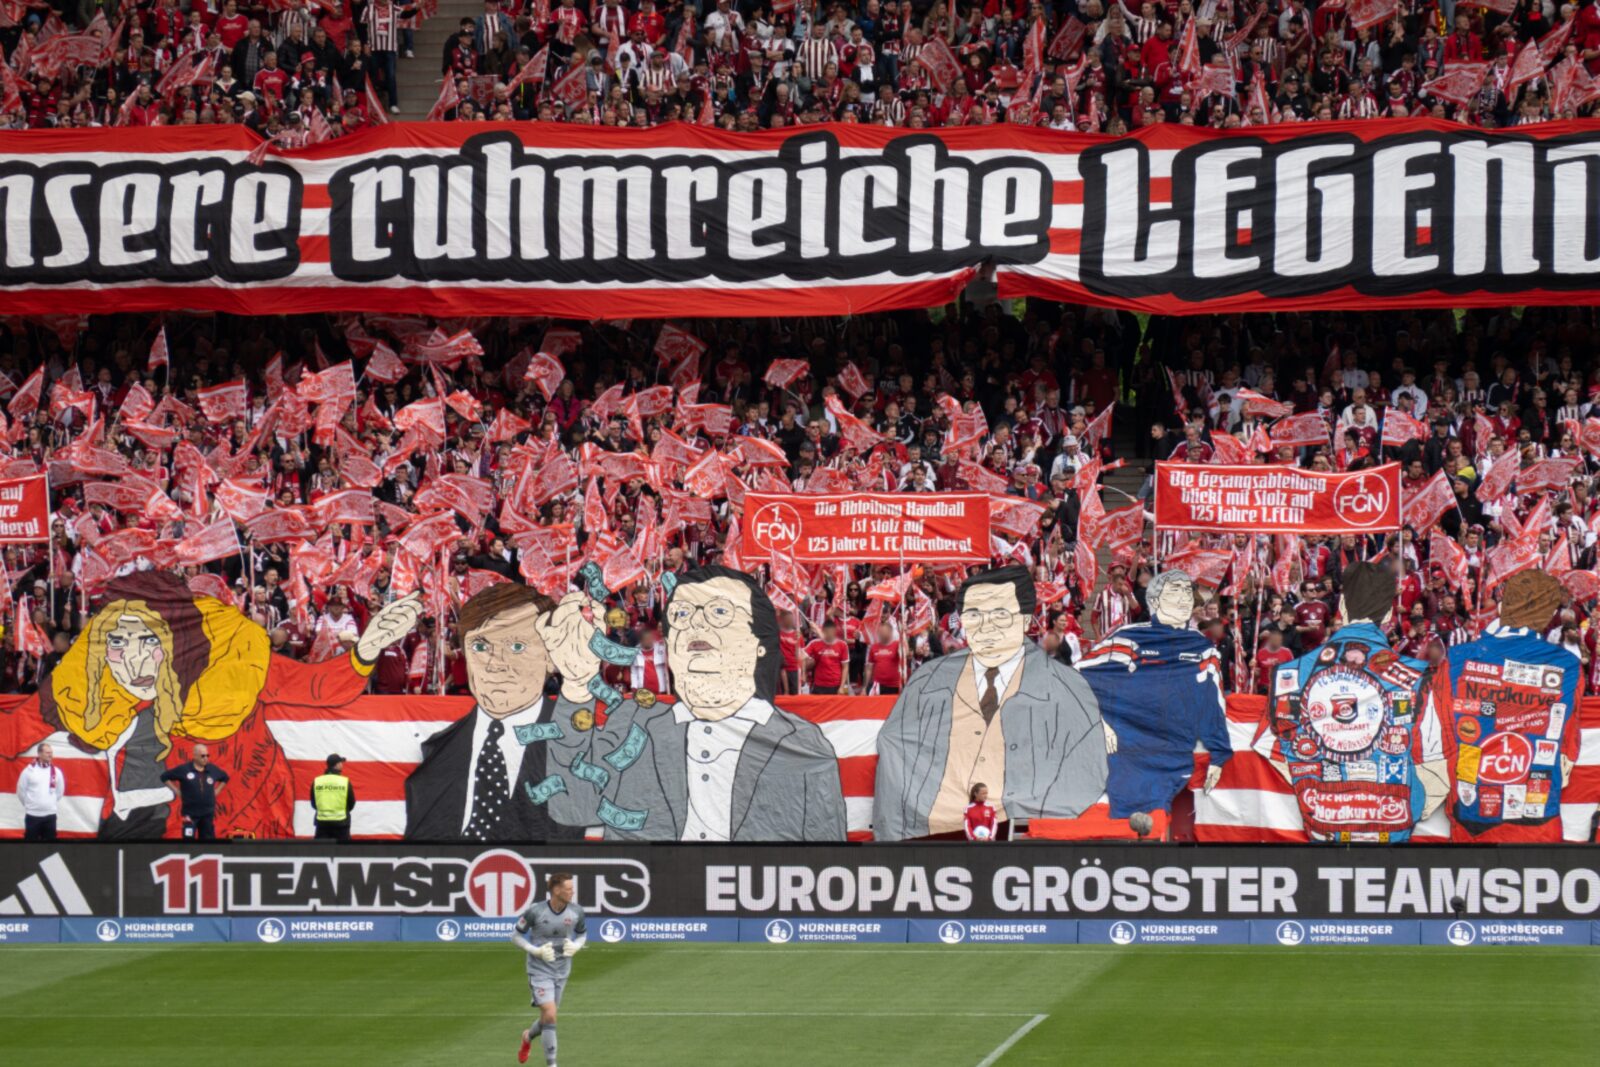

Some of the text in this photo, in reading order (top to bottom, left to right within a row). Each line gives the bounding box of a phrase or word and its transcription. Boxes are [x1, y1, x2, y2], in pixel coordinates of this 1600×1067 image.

[350, 141, 1042, 261] ruhmreiche
[1170, 470, 1327, 493] Die Gesangsabteilung
[0, 483, 24, 502] auf
[1181, 488, 1315, 510] blickt mit Stolz auf
[815, 500, 965, 517] Die Abteilung Handball
[1340, 492, 1383, 514] FCN
[1190, 504, 1214, 521] 125
[1217, 504, 1258, 524] Jahre
[756, 522, 796, 541] FCN
[851, 518, 925, 536] ist stolz auf
[808, 535, 973, 553] 125 Jahre 1. FC Nürnberg!
[1465, 681, 1556, 706] Nordkurve
[1500, 736, 1513, 754] 1.
[1480, 754, 1525, 774] FCN
[705, 866, 973, 912] EUROPAS
[992, 858, 1298, 913] GRÖSSTER
[125, 922, 194, 932] NÜRNBERGER
[291, 921, 374, 931] NÜRNBERGER
[291, 931, 350, 939] VERSICHERUNG
[631, 922, 707, 932] NÜRNBERGER
[799, 922, 881, 933] NÜRNBERGER
[970, 924, 1047, 933] NÜRNBERGER
[1141, 924, 1218, 934] NÜRNBERGER
[1310, 924, 1393, 935] NÜRNBERGER
[1481, 924, 1564, 935] NÜRNBERGER
[970, 933, 1025, 941] VERSICHERUNG
